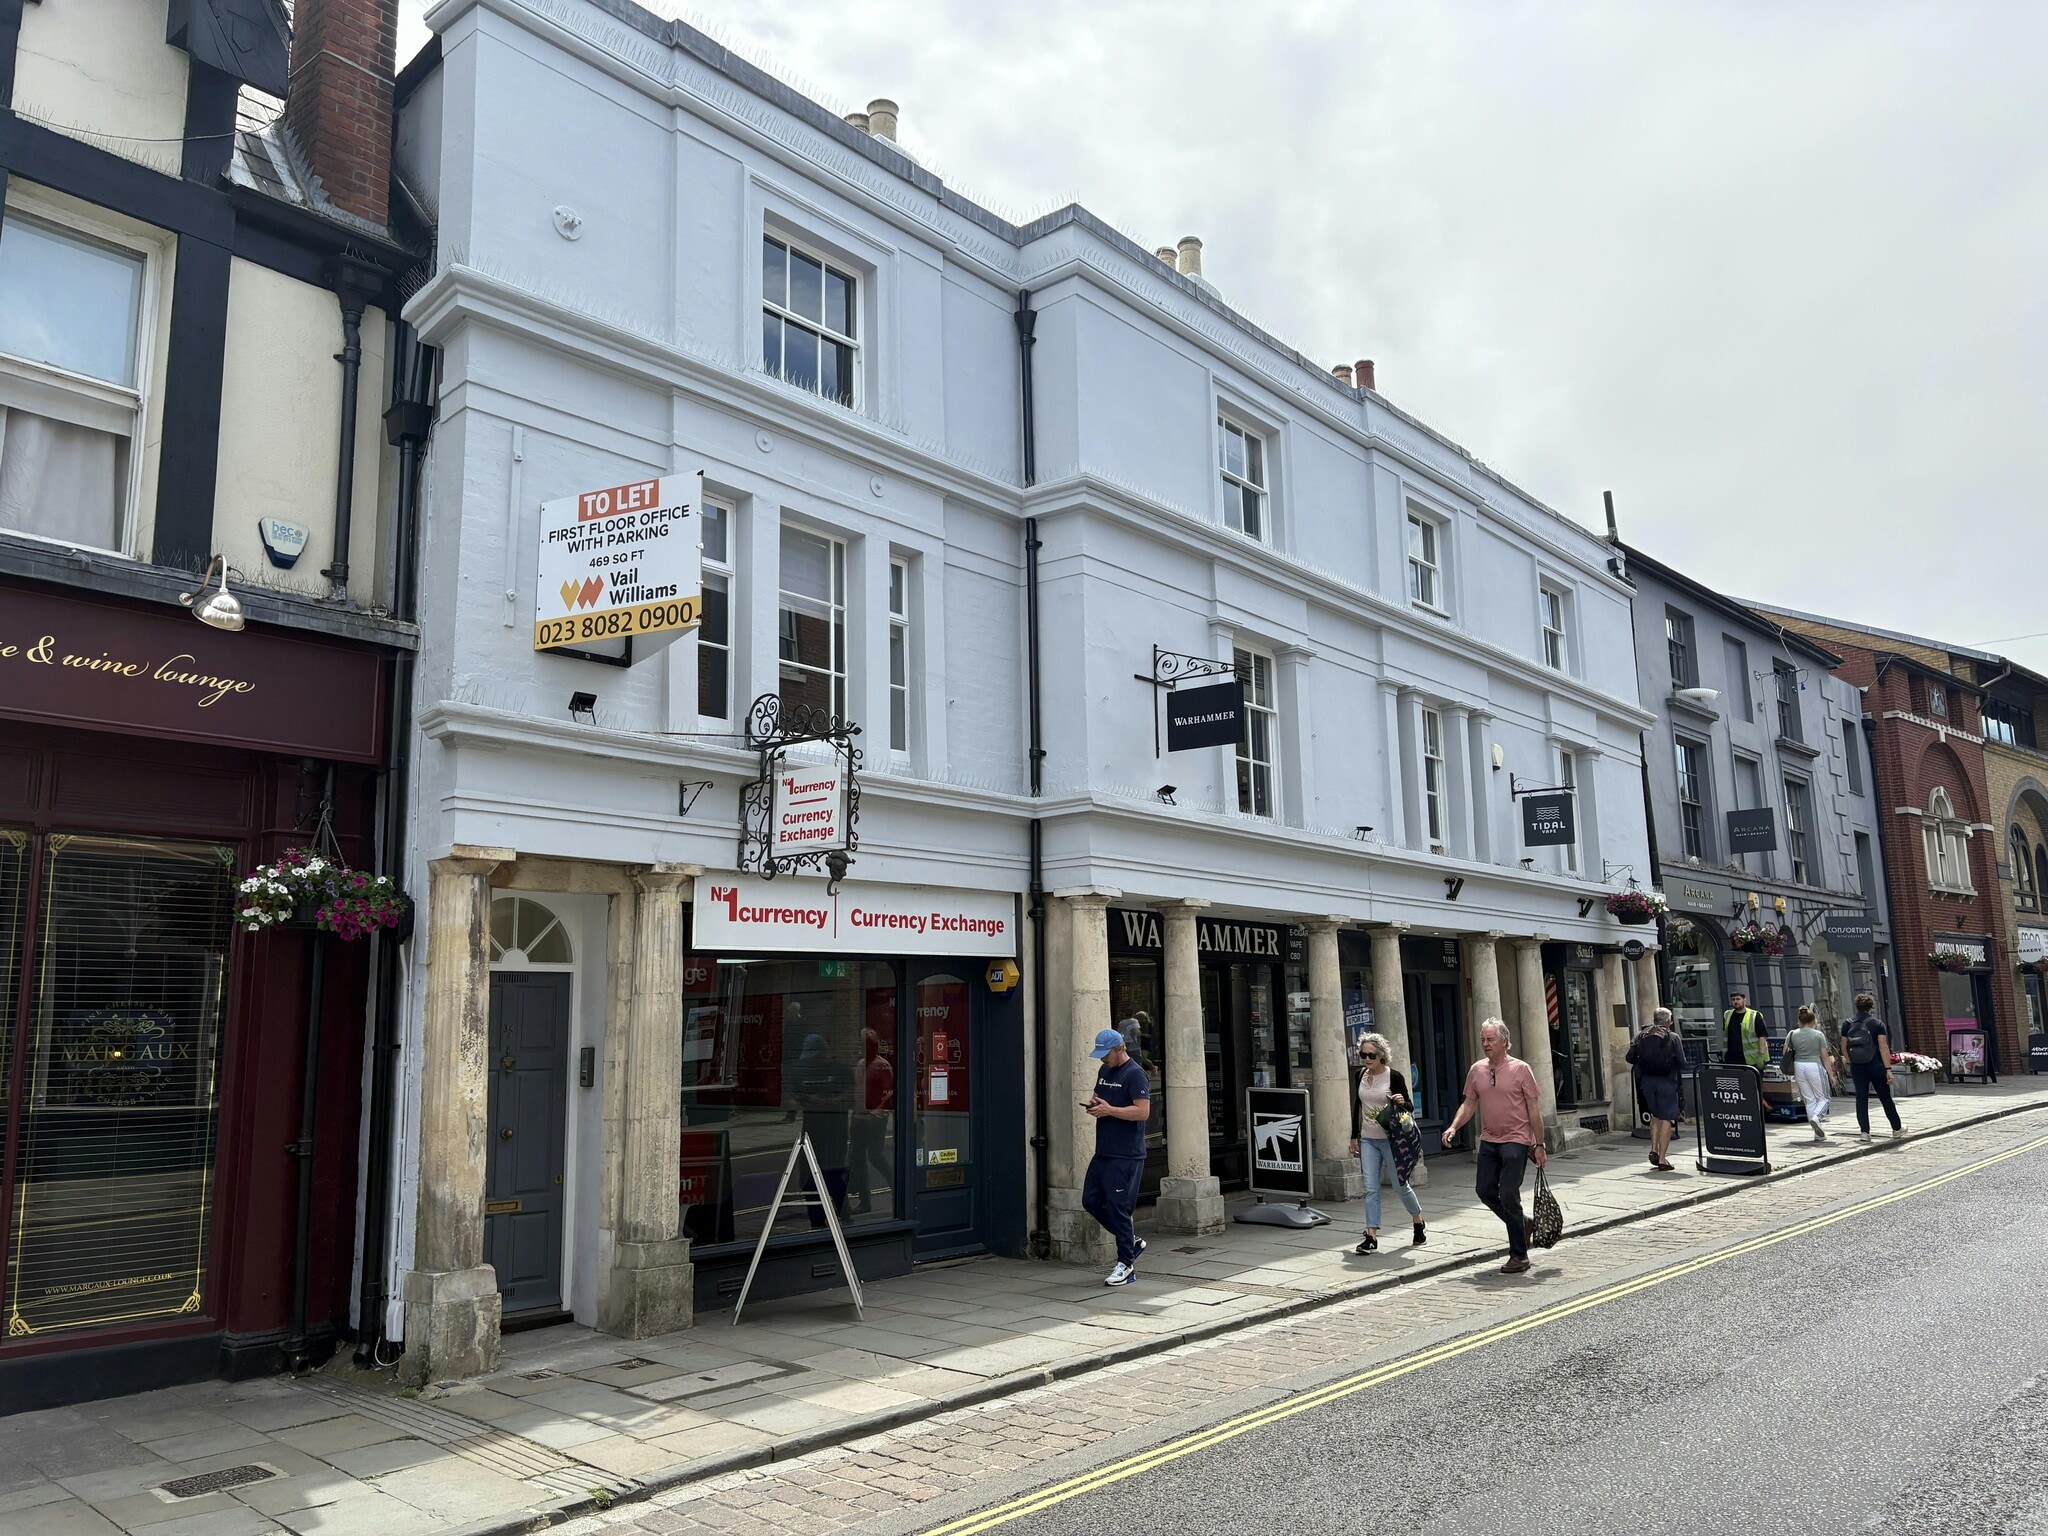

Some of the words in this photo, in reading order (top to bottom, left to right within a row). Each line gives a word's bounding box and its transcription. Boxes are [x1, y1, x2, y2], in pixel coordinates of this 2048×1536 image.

[584, 492, 610, 516] TO
[616, 483, 654, 510] LET
[549, 525, 585, 543] FIRST
[589, 516, 635, 536] FLOOR
[640, 504, 690, 525] OFFICE
[567, 536, 603, 553] WITH
[607, 524, 669, 547] PARKING
[589, 556, 609, 568] 469
[612, 553, 628, 564] SQ
[631, 550, 645, 561] FT
[610, 568, 638, 587] Vail
[609, 584, 677, 605] Williams
[539, 620, 576, 645] 023
[581, 611, 633, 638] 8082
[639, 602, 693, 630] 0900
[27, 635, 55, 664] &
[62, 652, 149, 677] wine
[153, 654, 256, 707] lounge
[1174, 710, 1235, 727] WARHAMMER
[782, 809, 833, 825] Currency
[1532, 821, 1566, 830] TIDAL
[780, 826, 834, 843] Exchange
[1684, 885, 1714, 900] ARCANA
[850, 908, 927, 934] Currency
[931, 913, 1005, 937] Exchange
[1121, 911, 1279, 956] WAAMMER
[1290, 940, 1303, 949] VAPE
[1290, 952, 1301, 960] CBD
[991, 971, 1003, 981] ADT
[61, 1043, 190, 1061] MARGAUX
[1712, 1091, 1747, 1100] TIDAL
[1711, 1112, 1752, 1121] E-CIGARETTE
[1257, 1161, 1302, 1171] WARHAMMER
